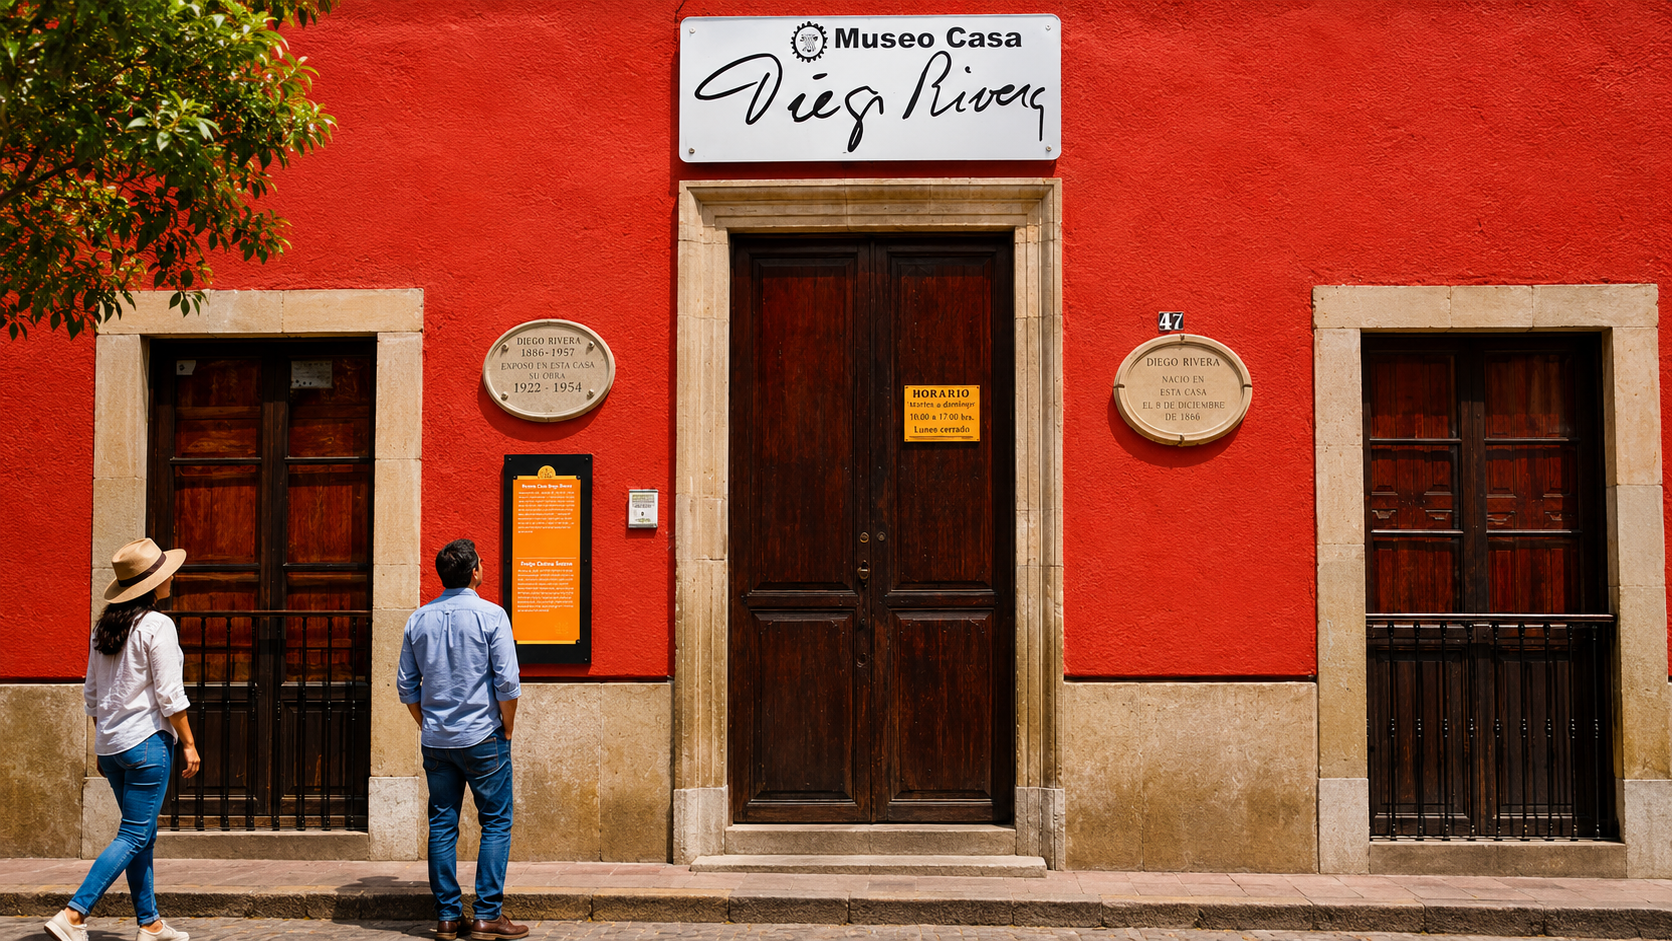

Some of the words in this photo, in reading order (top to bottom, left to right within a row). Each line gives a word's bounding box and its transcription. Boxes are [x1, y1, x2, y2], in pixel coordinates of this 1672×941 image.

[834, 27, 936, 50] Museo
[945, 26, 1023, 49] Casa
[902, 50, 1046, 142] Rivera
[1159, 312, 1183, 330] 47
[516, 337, 545, 346] DIEGO
[548, 336, 582, 345] RIVERA
[536, 362, 548, 370] EN
[550, 361, 570, 369] ESTA
[572, 361, 595, 369] CASA
[1146, 357, 1179, 367] DIEGO
[1183, 357, 1220, 367] RIVERA
[1161, 375, 1190, 384] NACIO
[1192, 375, 1205, 384] EN
[514, 382, 541, 393] 1922
[553, 382, 582, 393] 1954
[912, 389, 970, 398] HORARIO
[1160, 388, 1181, 397] ESTA
[1184, 388, 1207, 397] CASA
[1142, 401, 1153, 410] EL
[1163, 401, 1175, 410] DE
[1178, 401, 1226, 410] DICIEMBRE
[1165, 413, 1177, 421] DE
[939, 425, 970, 433] cerrado
